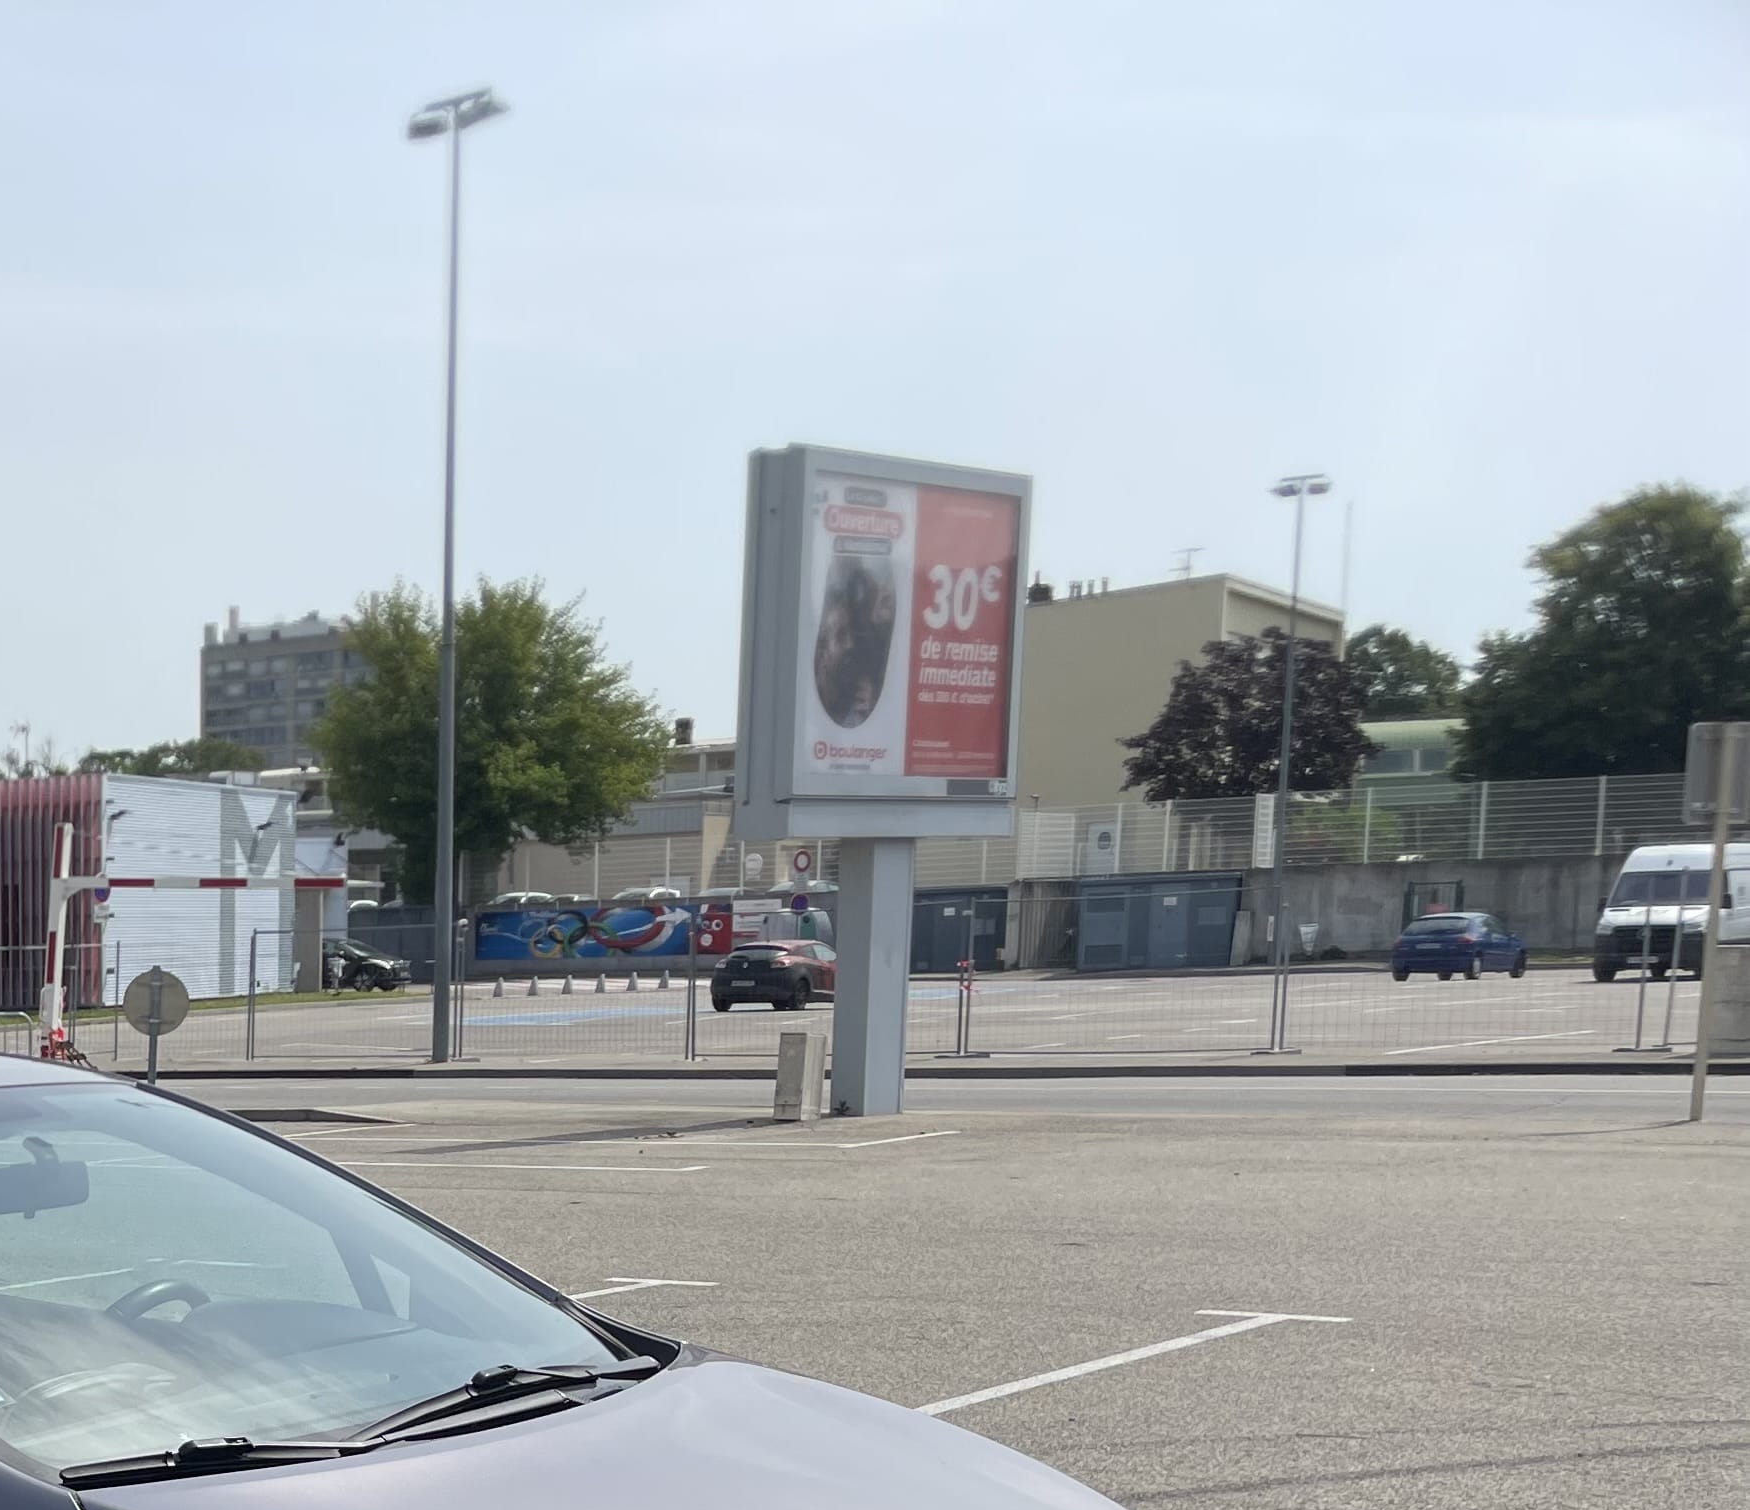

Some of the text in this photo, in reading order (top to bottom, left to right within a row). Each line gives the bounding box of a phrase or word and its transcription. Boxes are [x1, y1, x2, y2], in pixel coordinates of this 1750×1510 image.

[922, 564, 1003, 631] 30€
[920, 638, 999, 662] de remise
[918, 663, 997, 687] immédiate
[829, 744, 888, 762] boulanger
